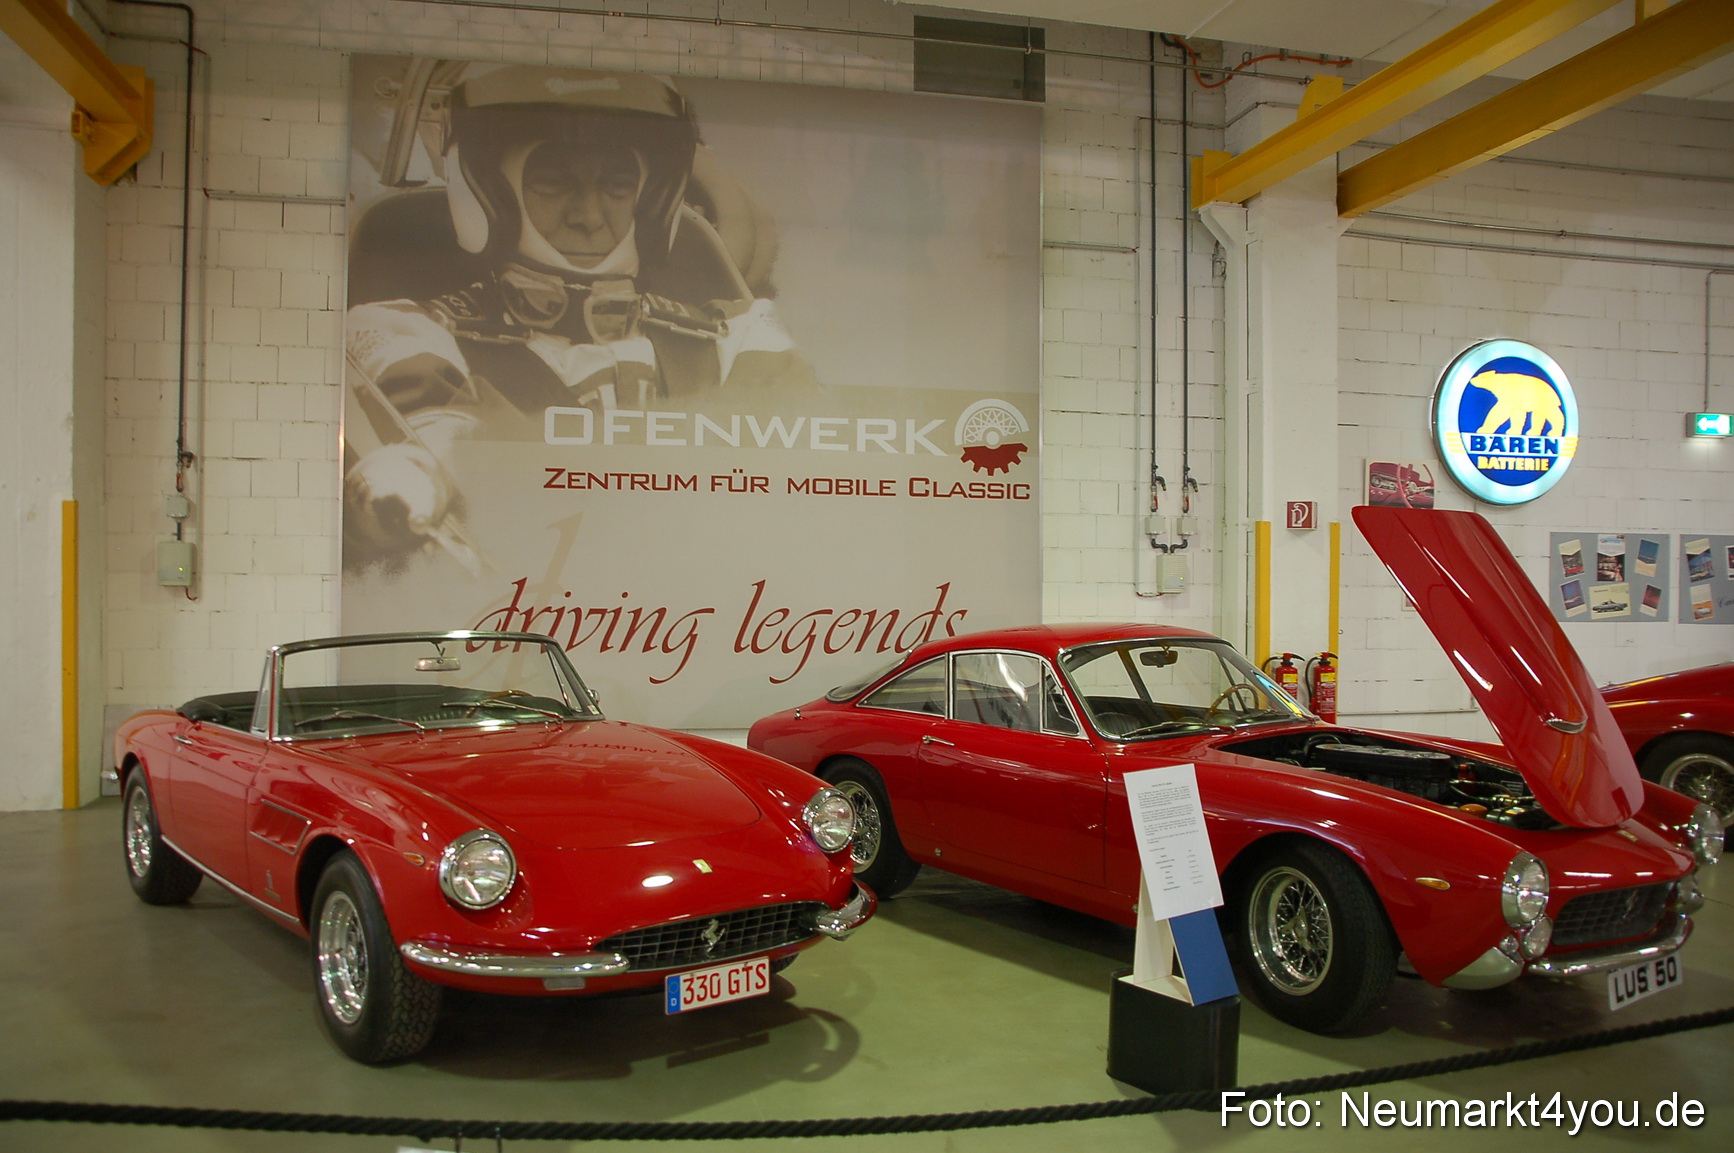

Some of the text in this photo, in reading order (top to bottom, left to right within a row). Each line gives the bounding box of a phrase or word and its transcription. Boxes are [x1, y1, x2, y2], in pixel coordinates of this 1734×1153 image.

[544, 405, 947, 457] OFENWERK
[1470, 435, 1559, 454] BÄREN
[543, 467, 698, 492] ZENTRUM
[908, 477, 1031, 500] CLASSIC
[1477, 456, 1549, 471] BATTERIE
[465, 577, 968, 684] driving legends
[683, 963, 766, 1005] 330 GTS
[1614, 956, 1677, 1003] LUS 50
